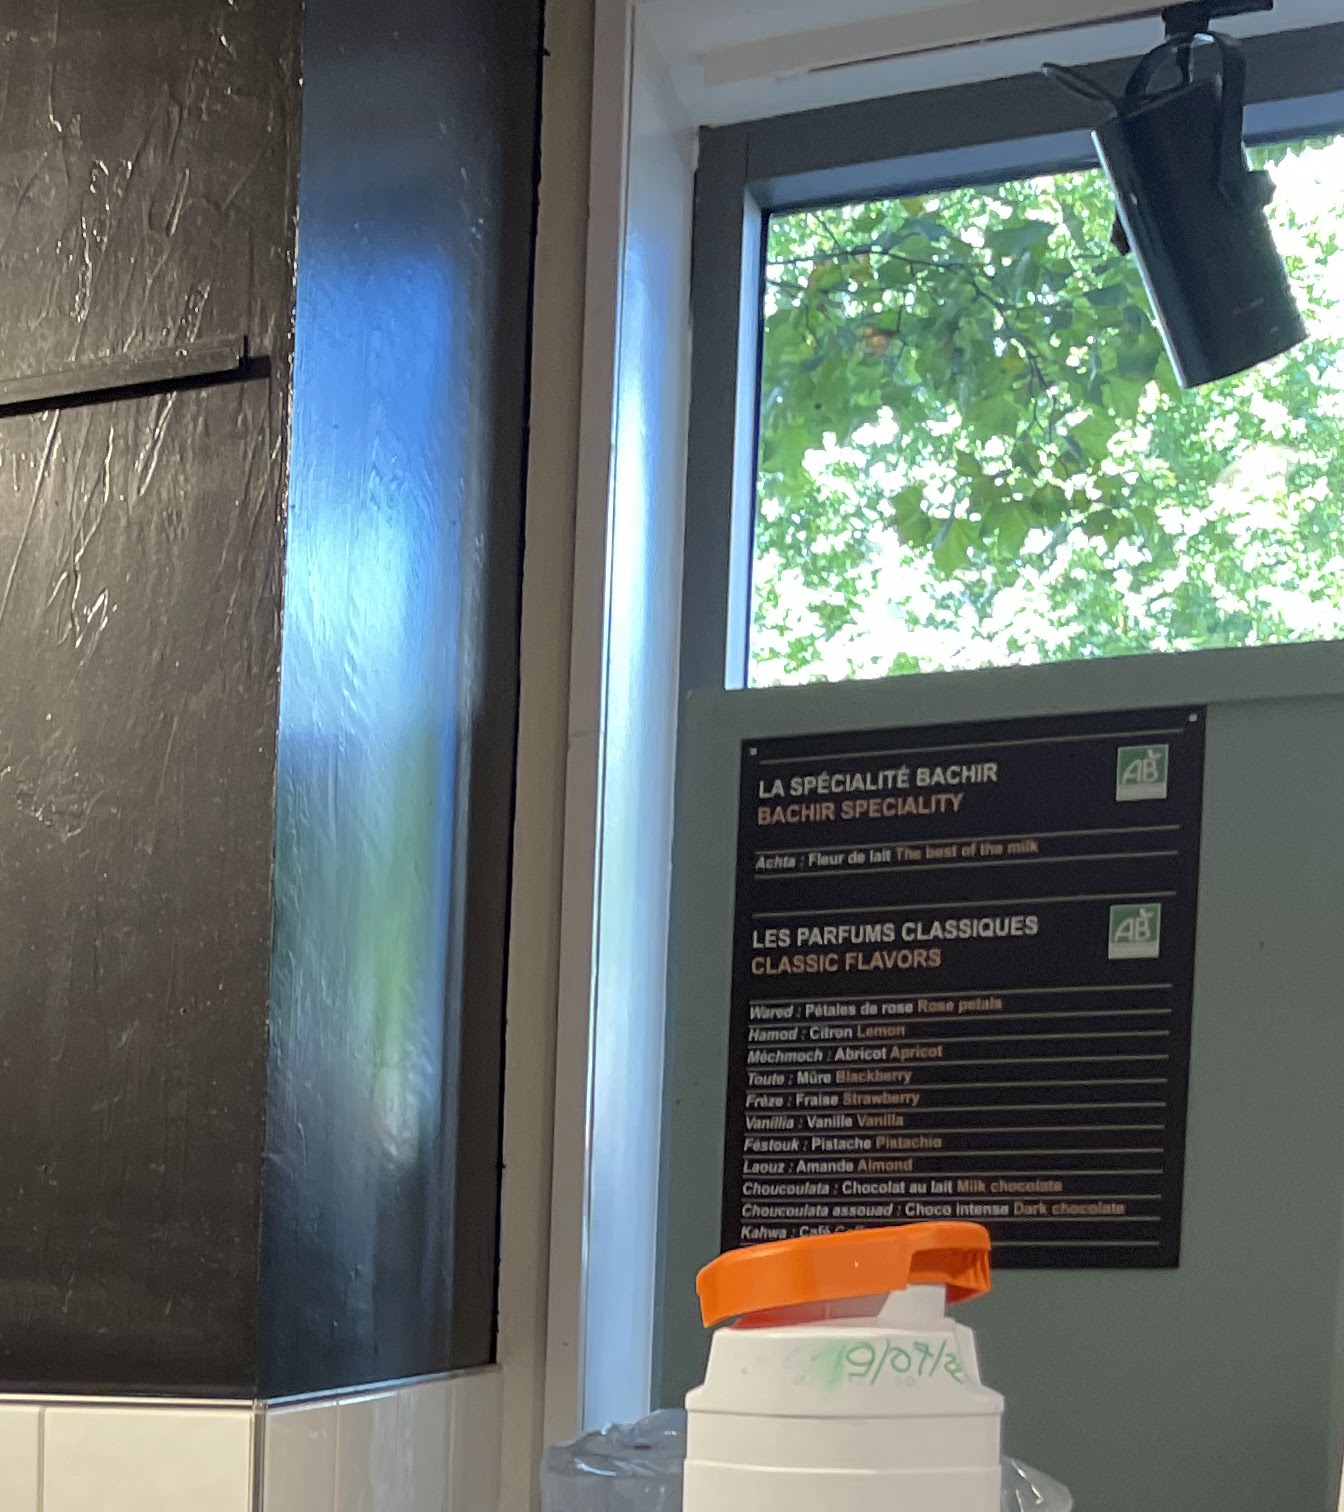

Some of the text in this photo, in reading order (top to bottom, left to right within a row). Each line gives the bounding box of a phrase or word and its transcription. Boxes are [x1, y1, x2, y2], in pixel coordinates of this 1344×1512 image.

[758, 761, 999, 800] LA SPÉCIALITÉ BACHIR
[757, 793, 965, 825] BACHIR SPECIALITY
[808, 850, 844, 867] Fleur
[847, 850, 865, 865] de
[869, 848, 891, 863] lait
[896, 845, 922, 861] The
[925, 844, 957, 859] best
[961, 842, 977, 858] of
[979, 841, 1004, 856] the
[1006, 839, 1039, 855] milk
[752, 914, 1038, 949] LES PARFUMS CLASSIQUES
[751, 948, 942, 975] CLASSIC FLAVORS
[805, 1002, 857, 1018] Pétales
[860, 1001, 878, 1015] de
[881, 1002, 913, 1015] rose
[917, 999, 954, 1013] Rose
[748, 1026, 798, 1041] Hamod
[810, 1025, 853, 1040] Citron
[857, 1024, 905, 1038] Lemon
[834, 1046, 887, 1062] Abricot
[890, 1044, 943, 1063] Apricot
[797, 1069, 832, 1084] Mûre
[836, 1068, 912, 1085] Blackberry
[796, 1091, 839, 1107] Fraise
[843, 1091, 920, 1107] Strawberry
[806, 1113, 853, 1128] Vanille
[857, 1112, 904, 1127] Vanilla
[811, 1135, 872, 1150] Pistache
[875, 1135, 942, 1149] Pistachio
[743, 1160, 785, 1174] Laouz
[796, 1158, 854, 1174] Amande
[857, 1157, 913, 1172] Almond
[841, 1179, 905, 1195] Chocolat
[909, 1182, 927, 1193] au
[930, 1179, 953, 1194] lait
[957, 1178, 985, 1193] Milk
[990, 1178, 1063, 1193] chocolate
[832, 1202, 893, 1217] assouad
[905, 1201, 952, 1217] Choco
[1013, 1201, 1047, 1216] Dark
[1051, 1199, 1125, 1215] chocolate
[740, 1224, 787, 1240] Kahwa
